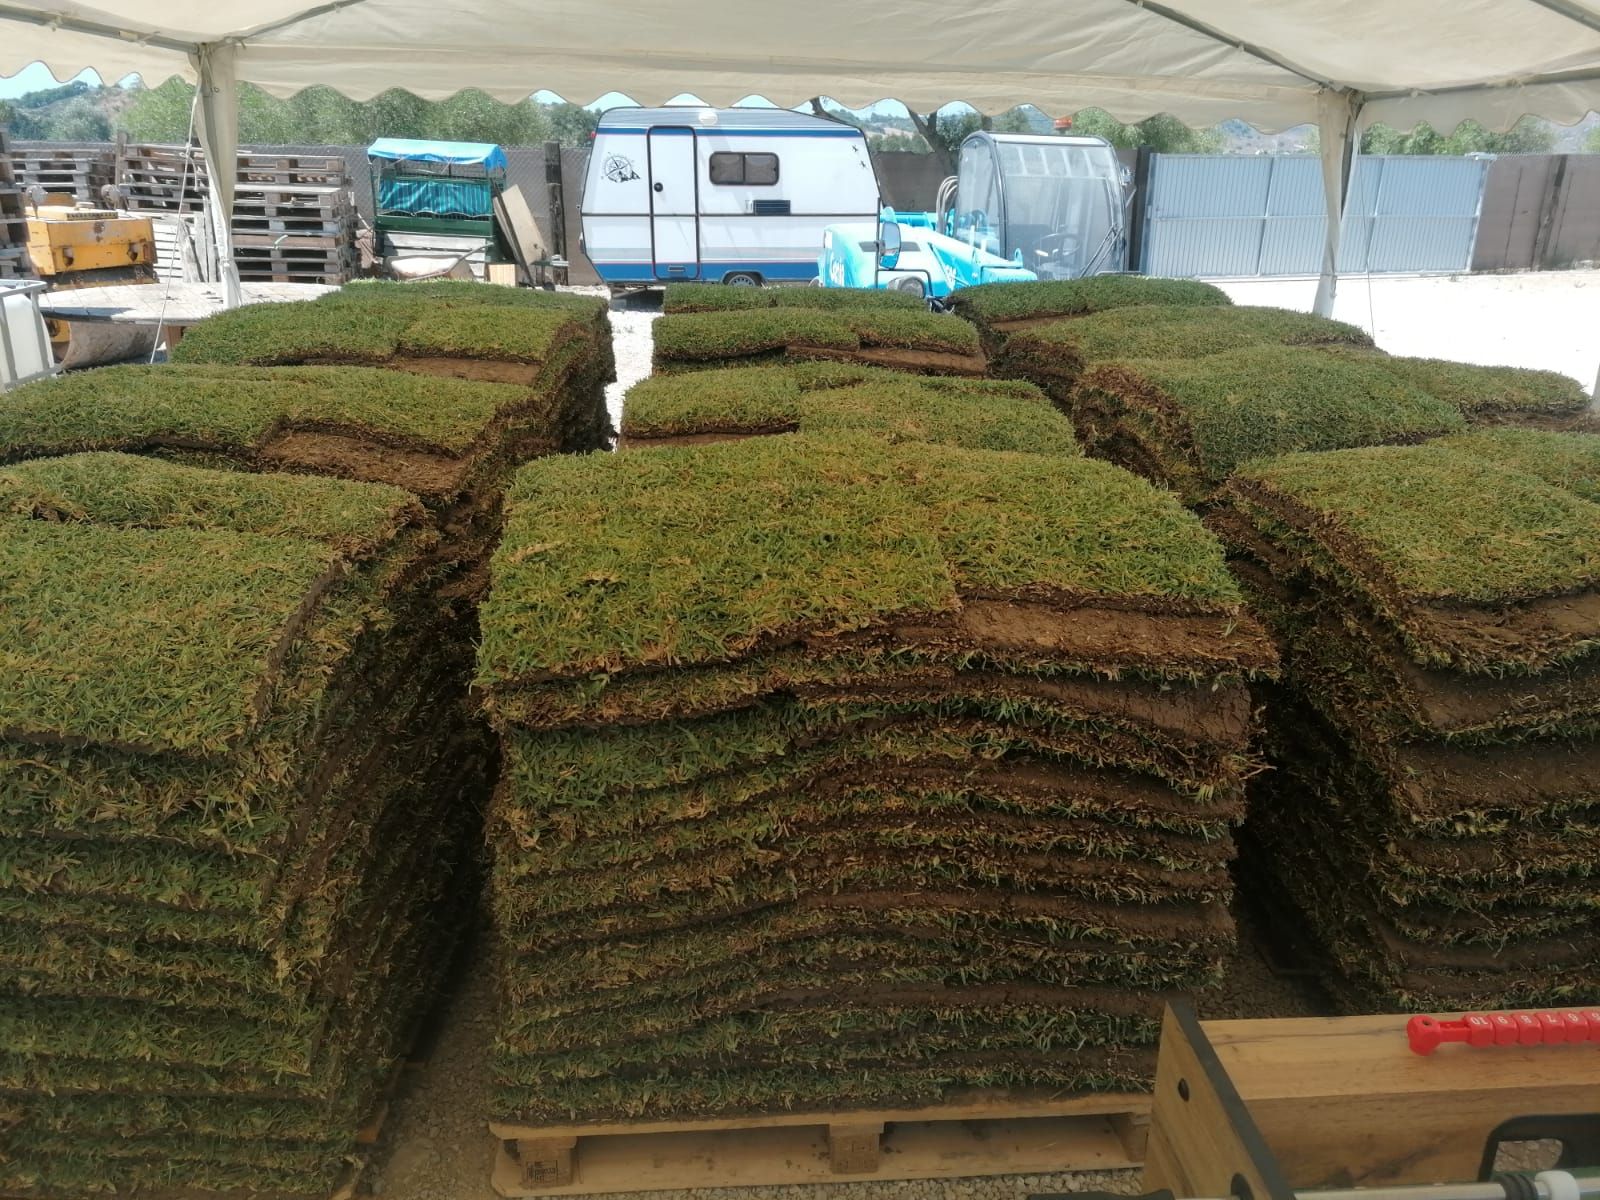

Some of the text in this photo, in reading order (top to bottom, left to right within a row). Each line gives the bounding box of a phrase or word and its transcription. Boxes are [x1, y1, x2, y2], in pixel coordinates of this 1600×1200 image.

[1470, 1016, 1488, 1025] 10
[1498, 1016, 1508, 1024] 9
[1520, 1015, 1532, 1024] 8
[1546, 1014, 1557, 1023] 7
[1568, 1013, 1578, 1022] 6
